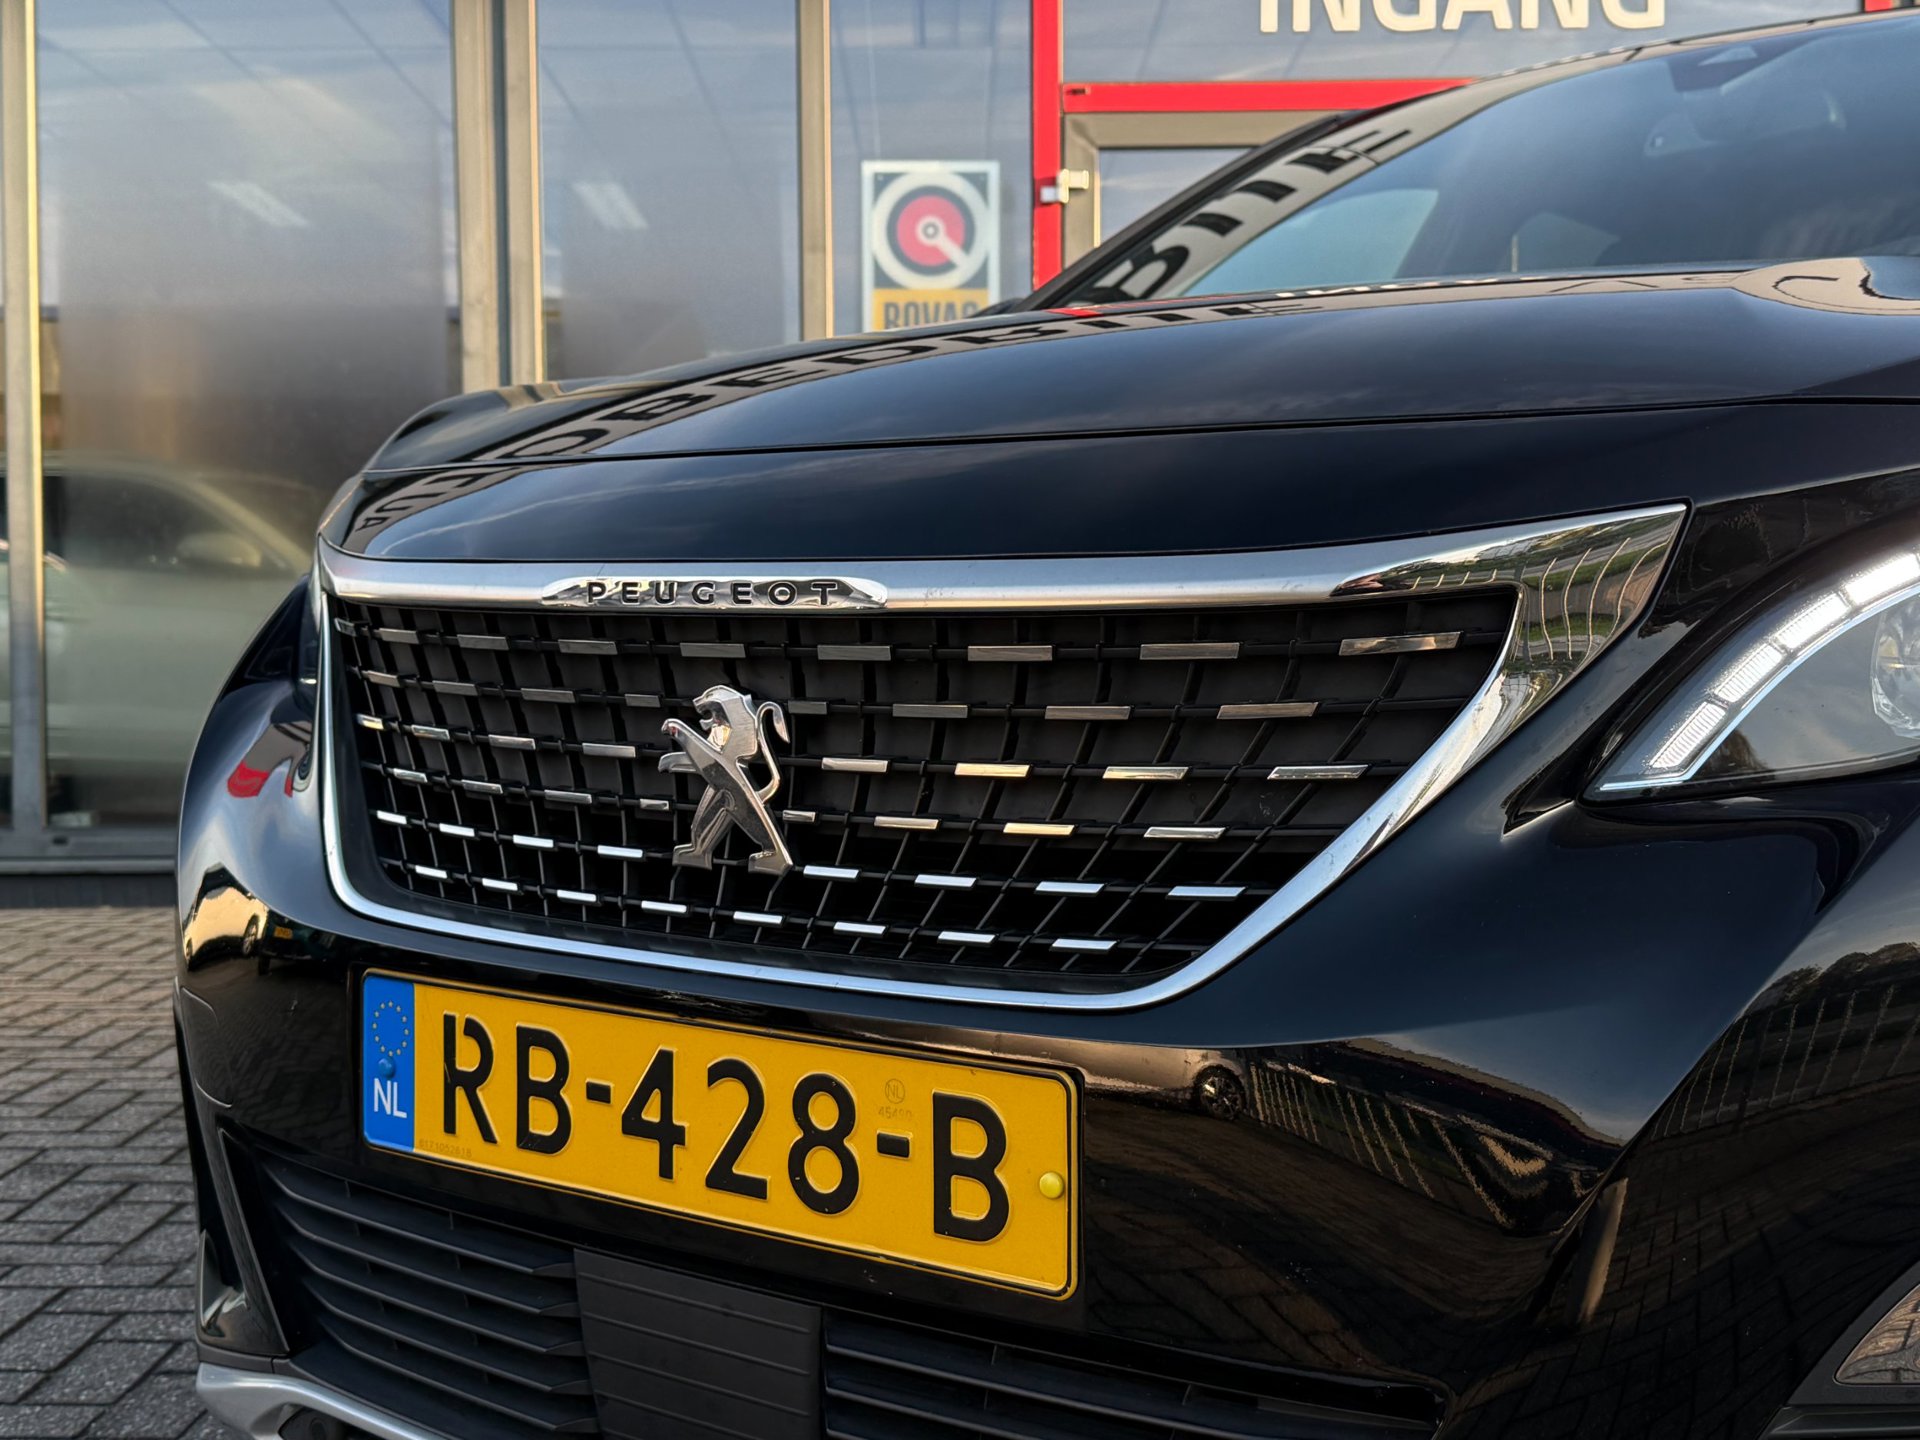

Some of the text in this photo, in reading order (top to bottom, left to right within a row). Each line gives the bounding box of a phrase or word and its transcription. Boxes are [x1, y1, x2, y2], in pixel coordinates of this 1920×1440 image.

[587, 581, 837, 606] PEUGEOT
[373, 1077, 408, 1119] NL
[442, 1010, 1011, 1243] RB-428-B
